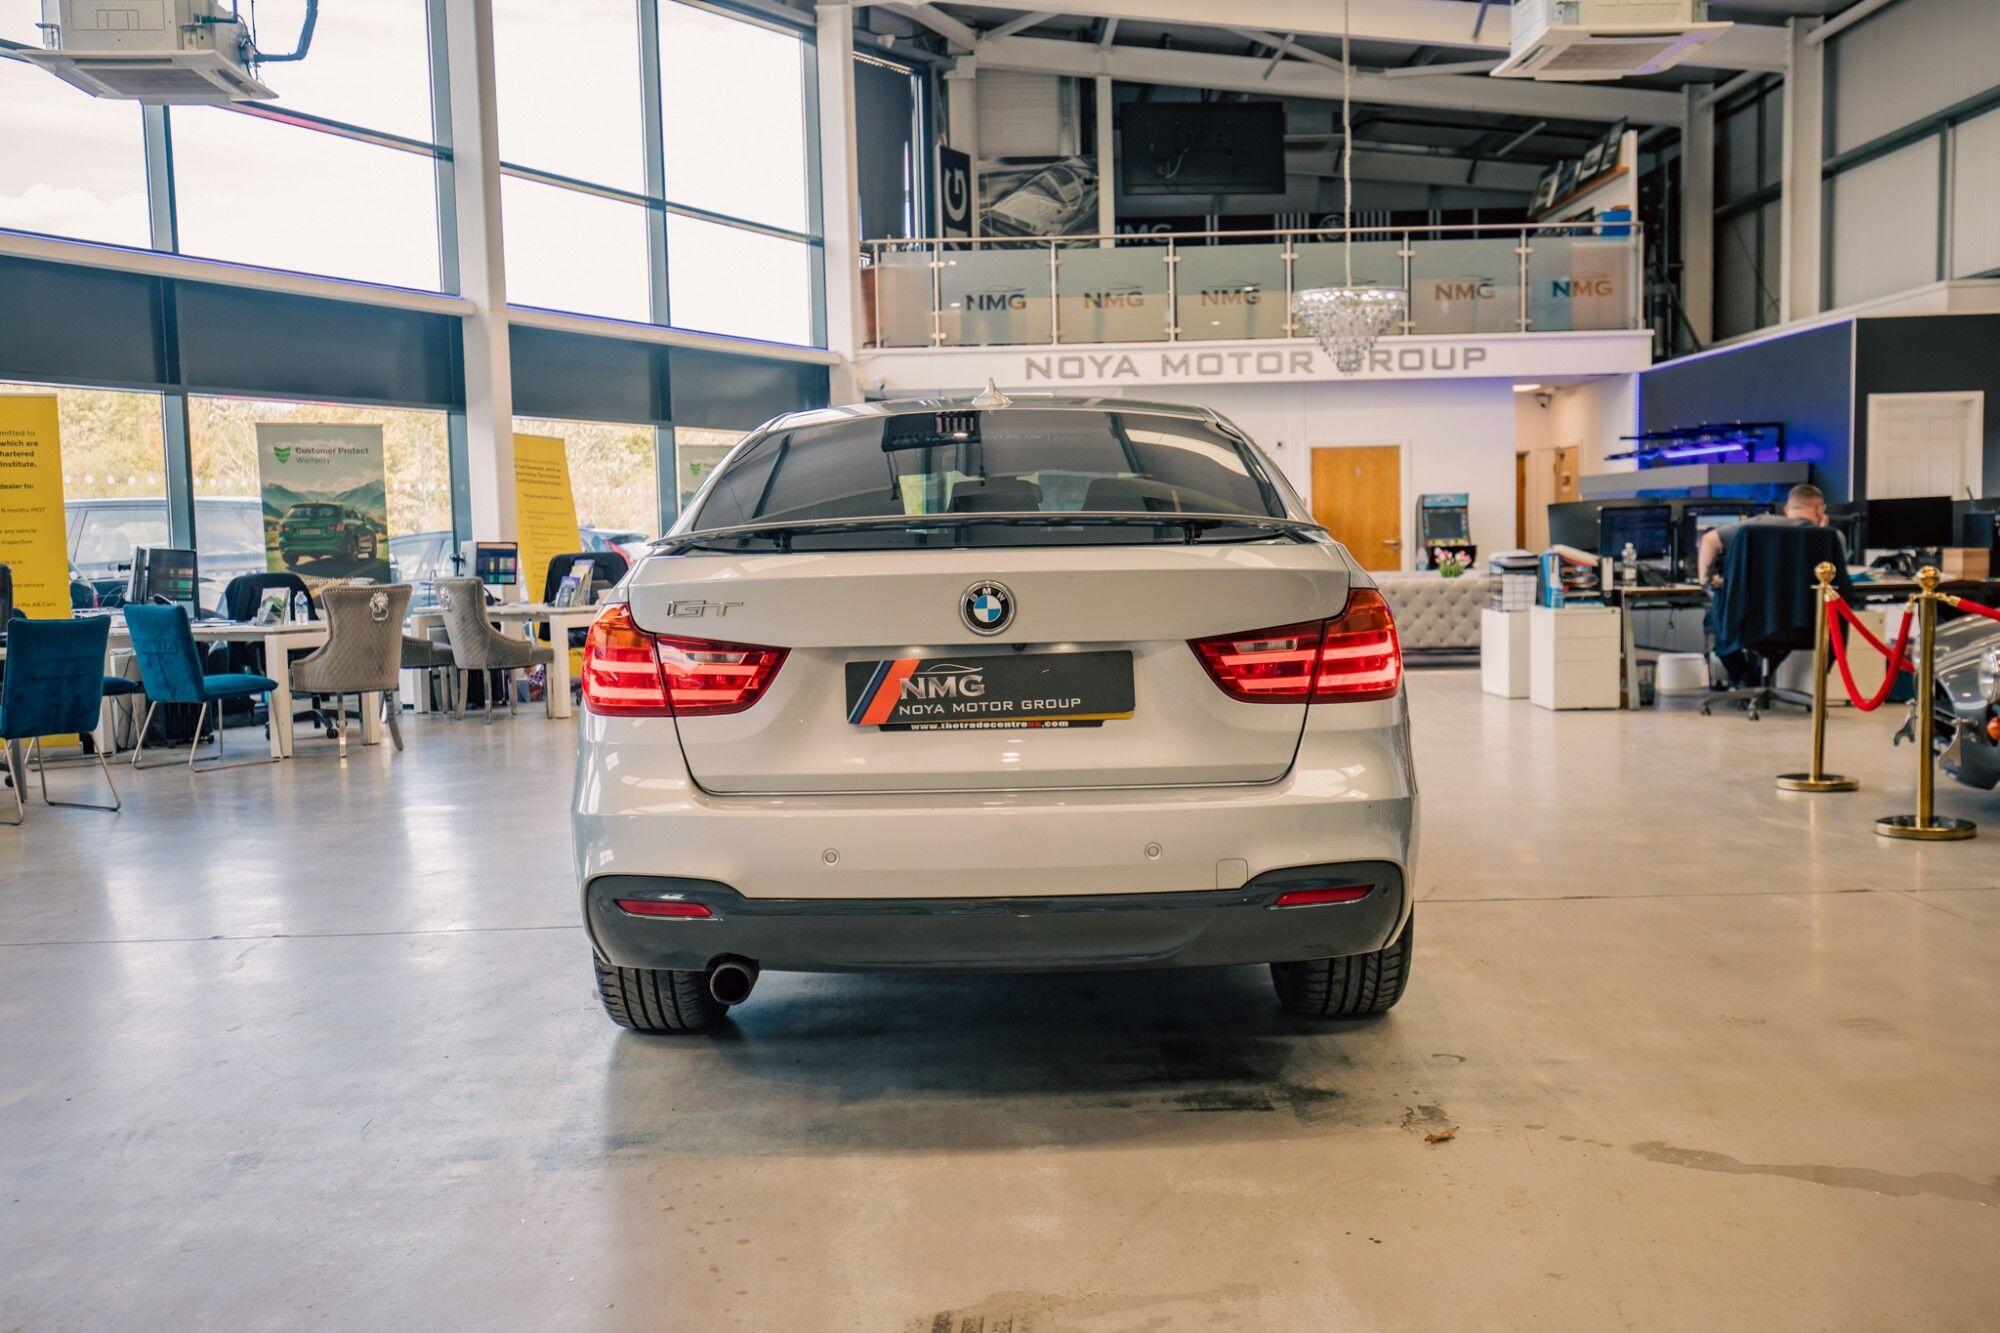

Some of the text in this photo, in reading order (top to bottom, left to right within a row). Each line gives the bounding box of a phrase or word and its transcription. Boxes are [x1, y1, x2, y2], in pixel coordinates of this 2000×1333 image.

[1200, 289, 1262, 306] NMG
[1435, 283, 1496, 300] NMG
[1552, 279, 1613, 298] NMG
[966, 293, 1027, 311] NMG
[1084, 291, 1145, 309] NMG
[1025, 354, 1140, 380] NOYA
[1161, 351, 1315, 377] MOTOR
[297, 457, 330, 465] Warranty
[969, 586, 1007, 602] BMW
[667, 600, 745, 618] GT
[899, 674, 986, 700] NMG
[899, 698, 1081, 716] NOYA MOTOR GROUP
